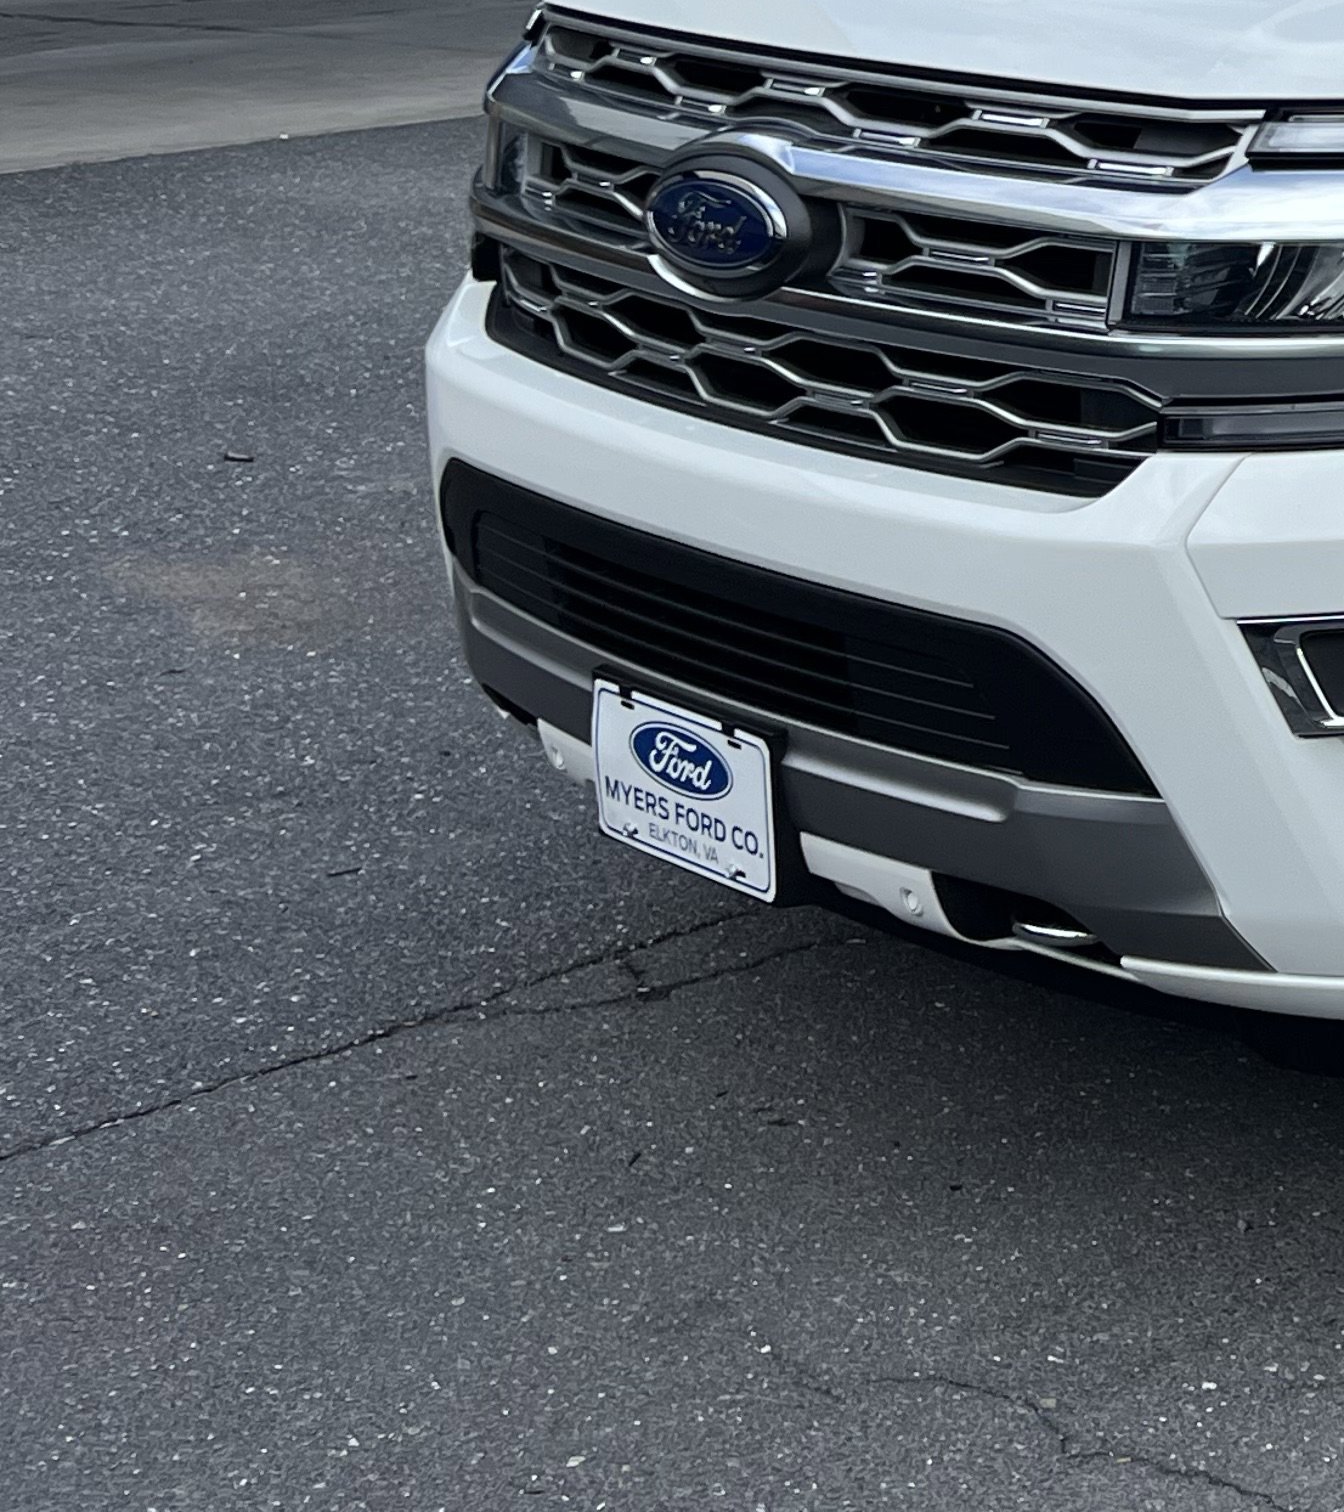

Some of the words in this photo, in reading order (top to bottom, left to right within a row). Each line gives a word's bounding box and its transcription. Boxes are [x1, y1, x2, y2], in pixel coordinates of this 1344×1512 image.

[649, 731, 712, 791] Ford
[604, 775, 670, 821] MYERS
[675, 802, 727, 843] FORD
[731, 825, 765, 860] CO.
[648, 822, 700, 860] ELKTON,
[702, 844, 719, 865] VA
